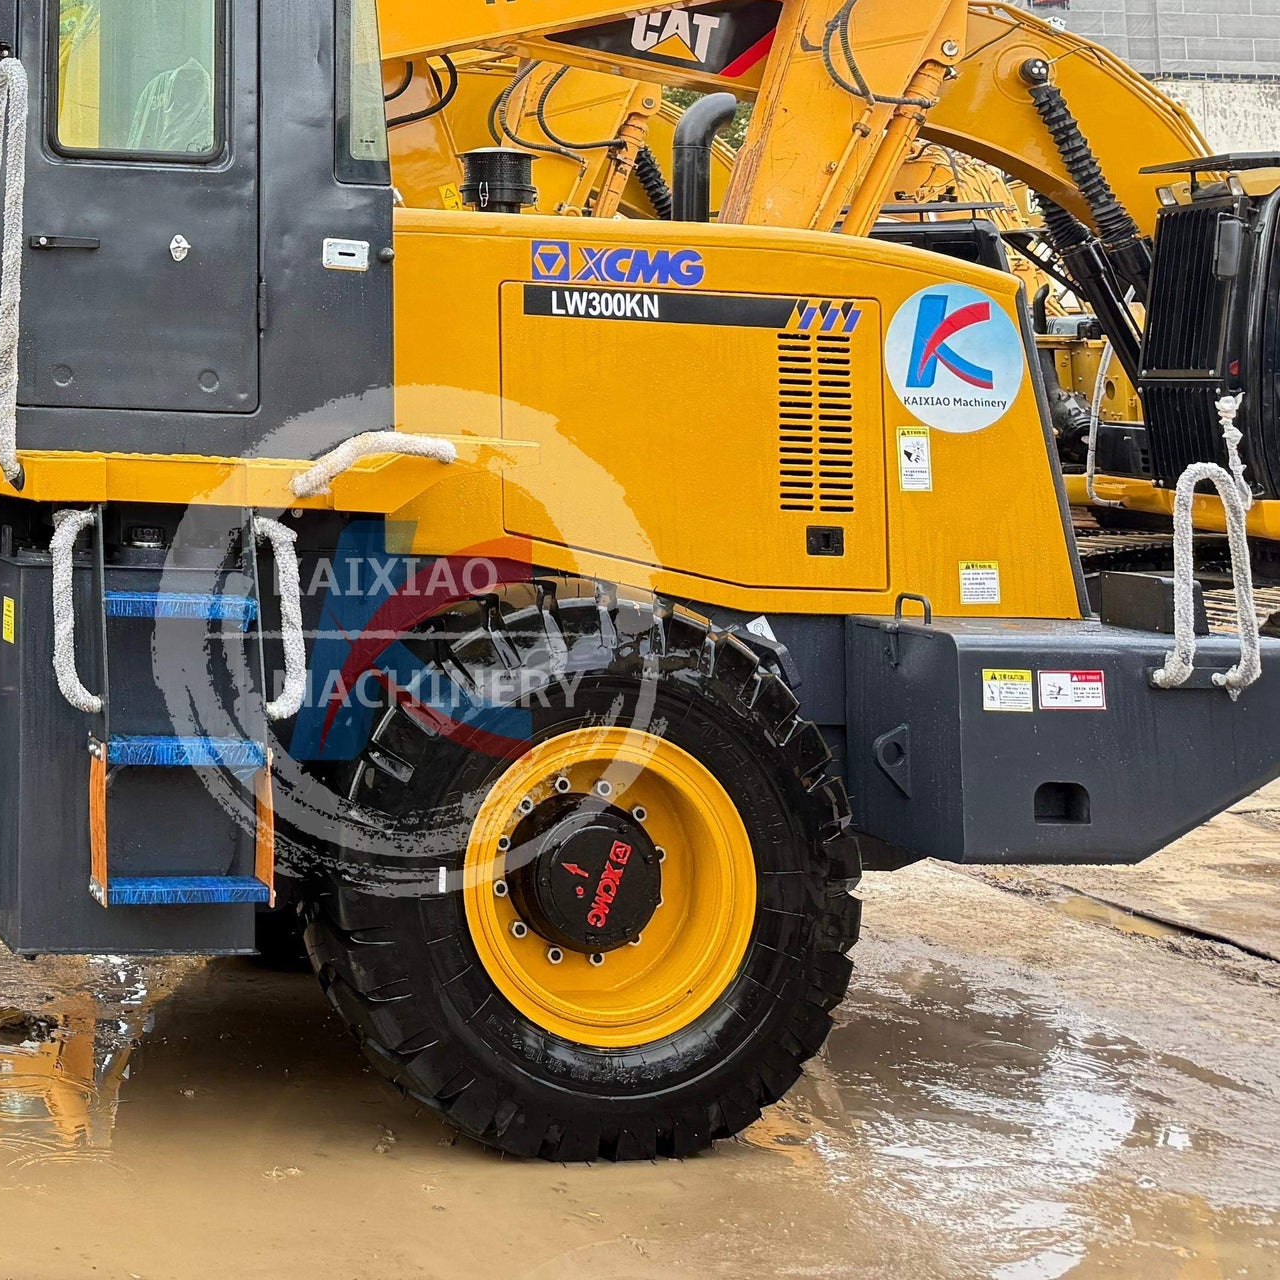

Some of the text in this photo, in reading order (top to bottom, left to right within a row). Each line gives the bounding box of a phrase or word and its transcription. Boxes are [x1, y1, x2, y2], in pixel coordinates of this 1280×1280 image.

[630, 9, 720, 63] CAT
[572, 247, 705, 287] XCMG
[551, 290, 659, 318] LW300KN
[903, 396, 1007, 410] KAIXIAO Machinery
[587, 860, 624, 928] XCMG
